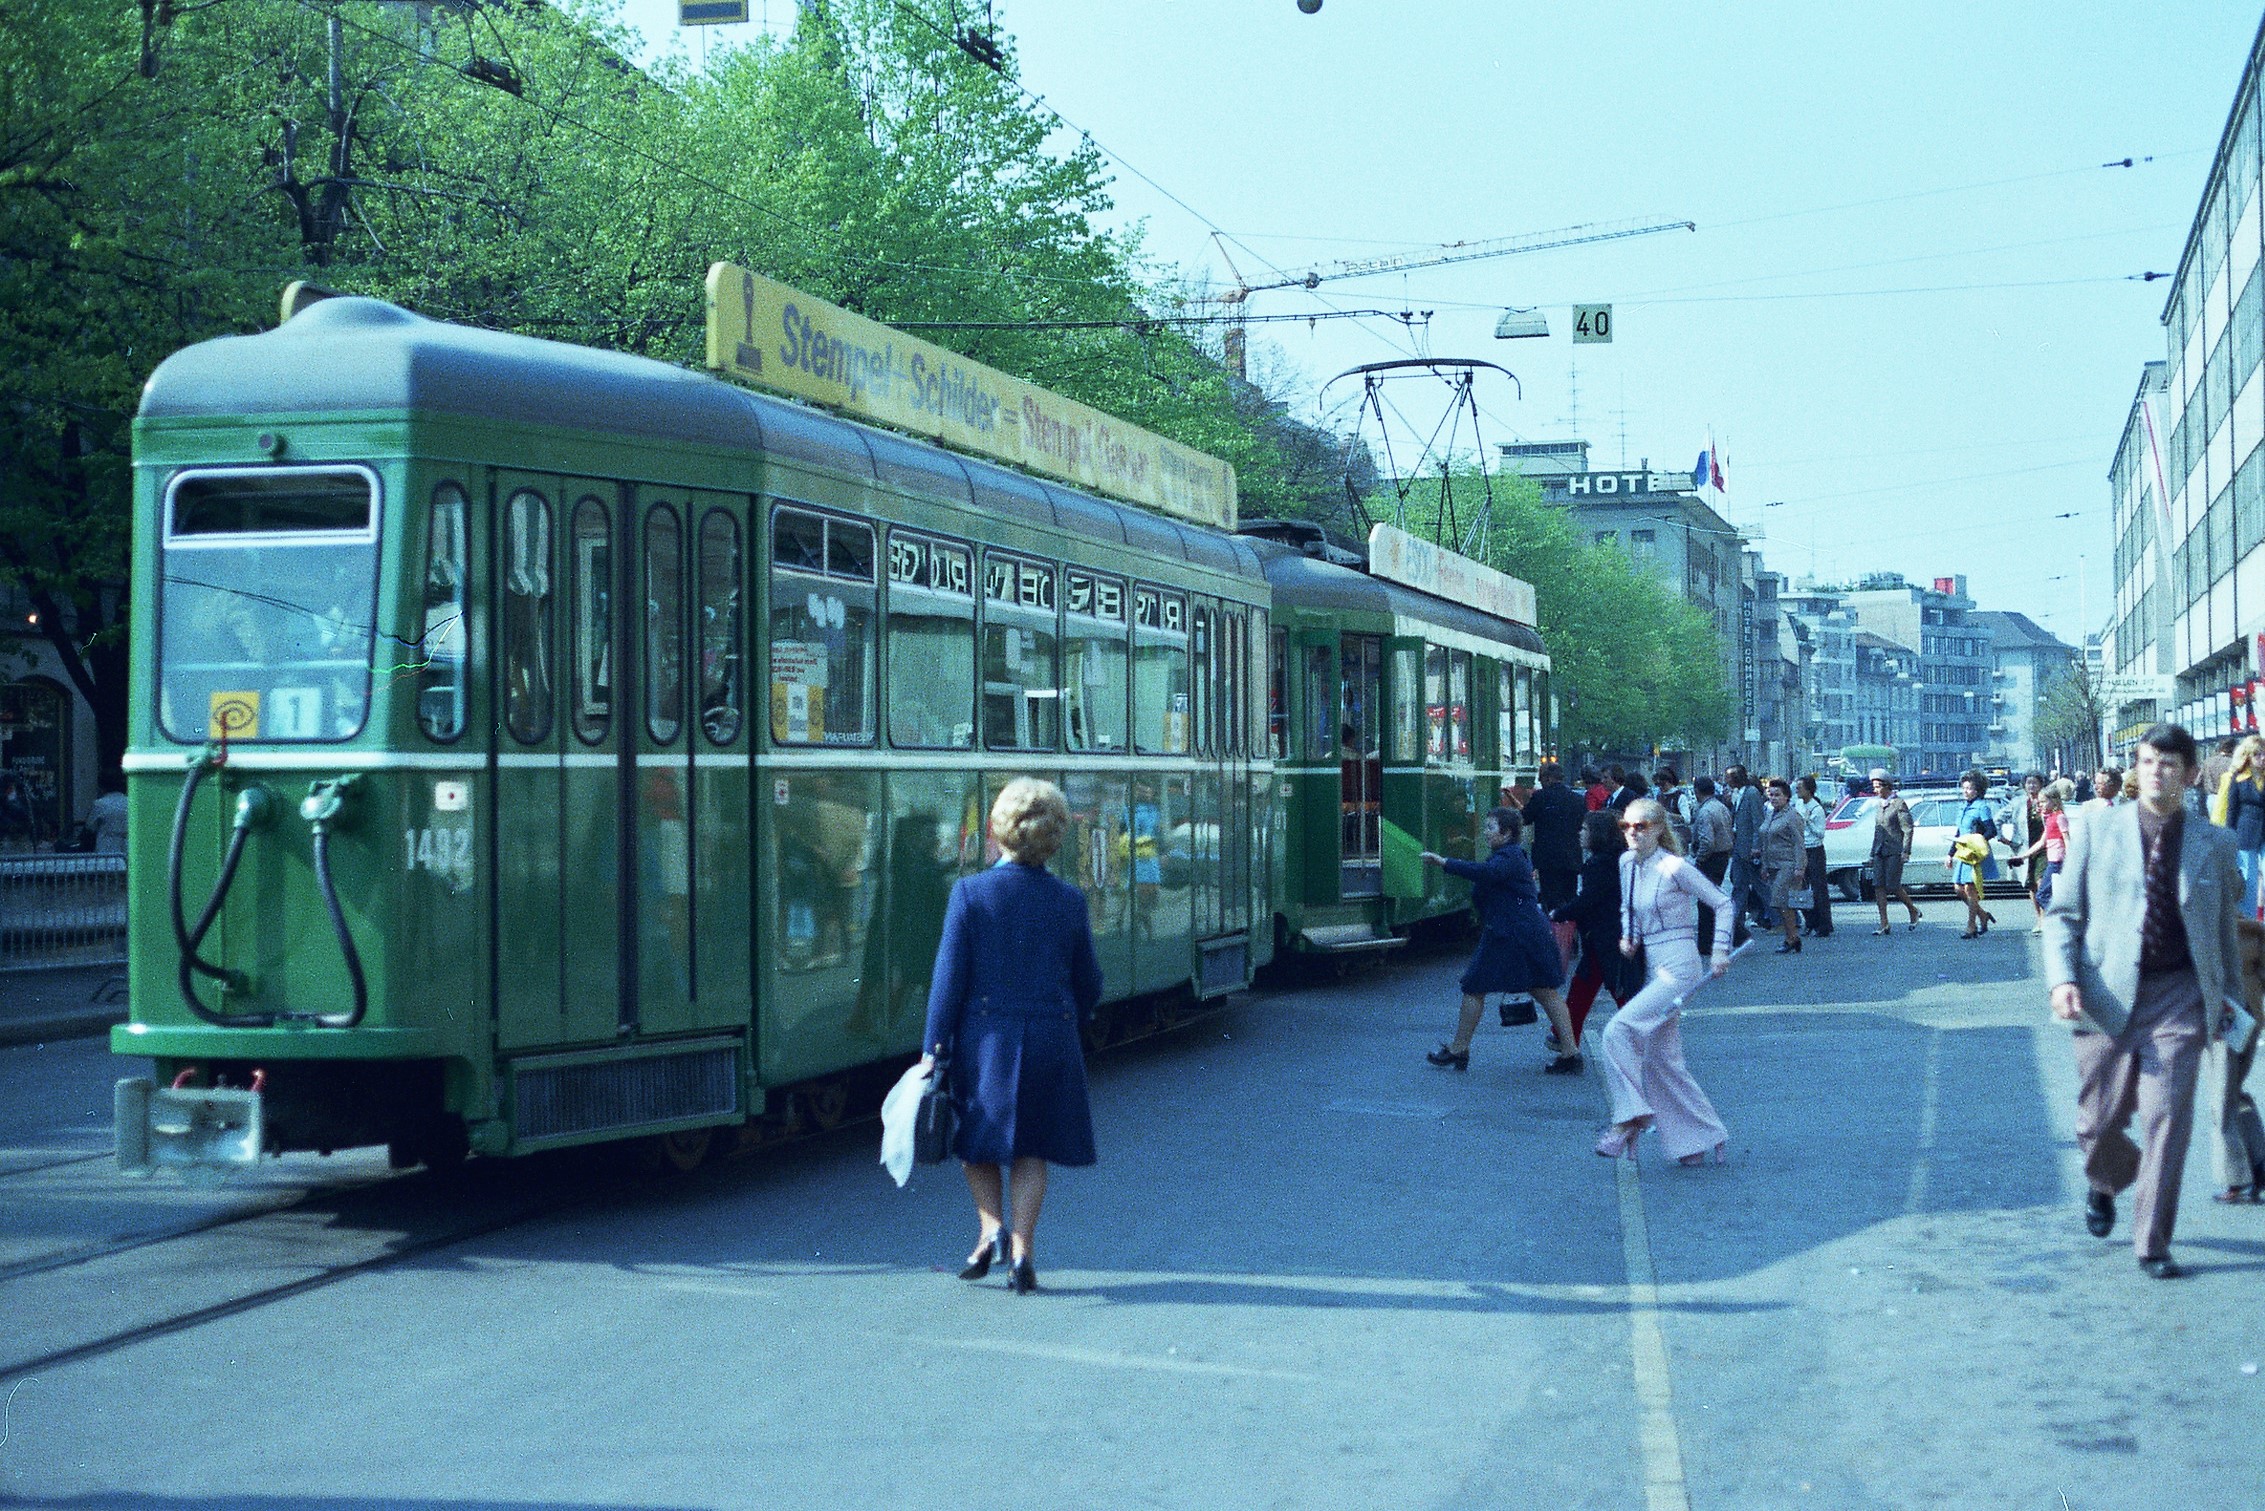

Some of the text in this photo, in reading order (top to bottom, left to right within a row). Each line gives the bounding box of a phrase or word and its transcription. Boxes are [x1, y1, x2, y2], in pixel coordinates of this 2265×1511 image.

[1576, 311, 1609, 336] 40
[779, 303, 893, 401] Stempel
[911, 352, 999, 432] Schilder
[1743, 601, 1751, 642] HOTEL
[288, 696, 301, 732] 1
[405, 828, 470, 870] 1492
